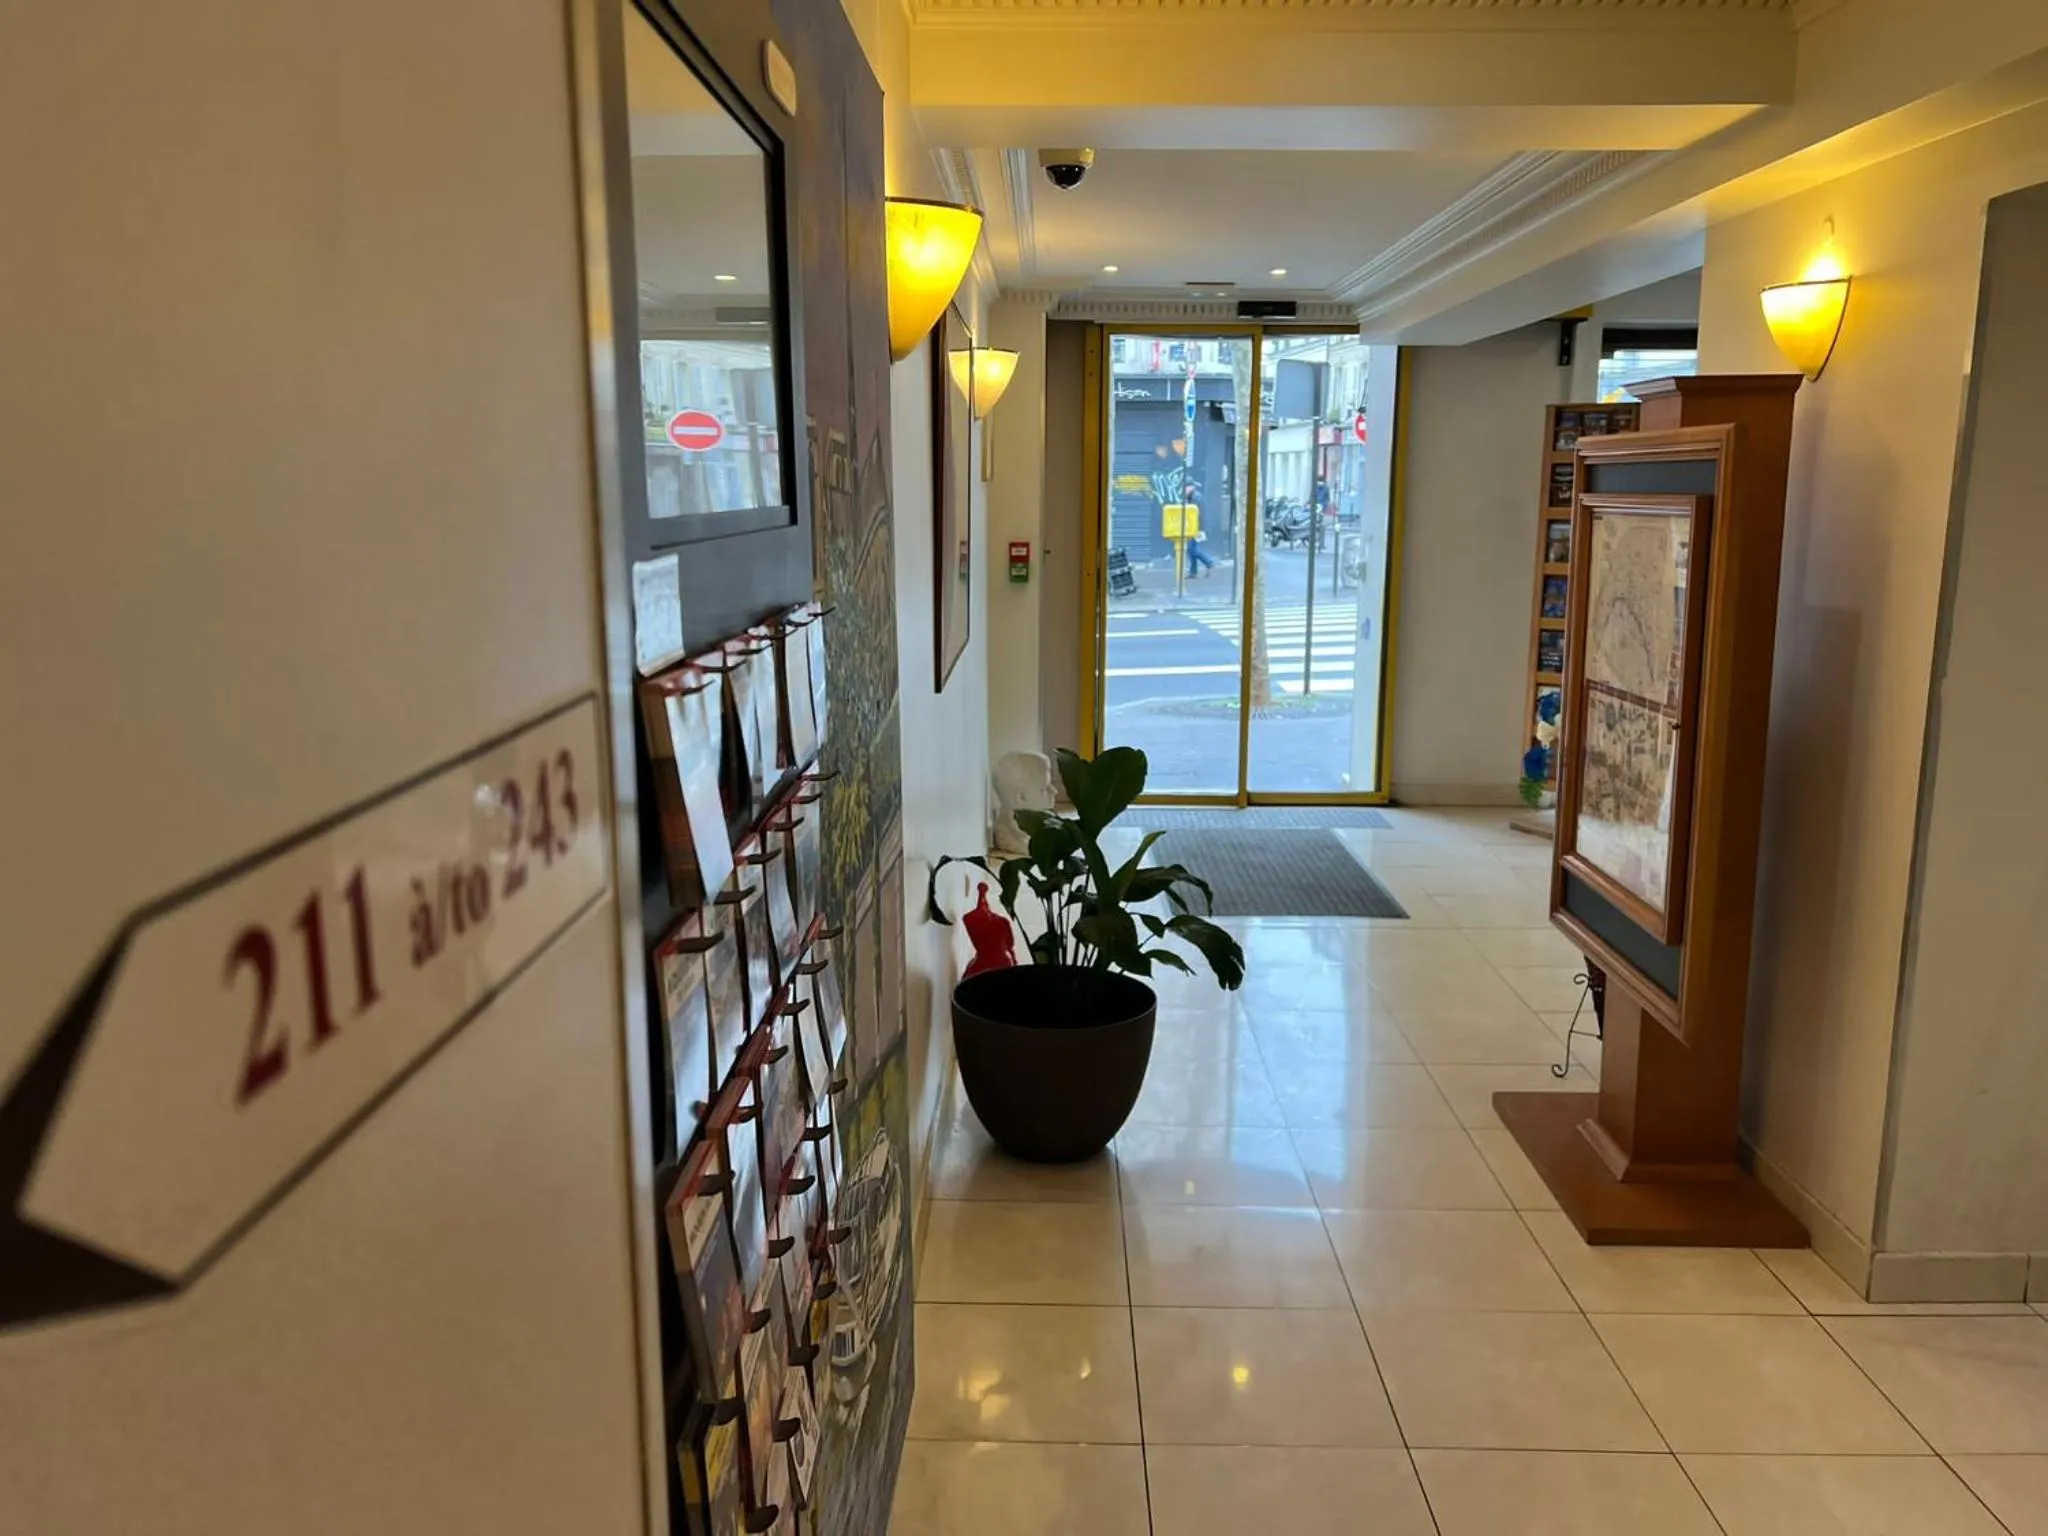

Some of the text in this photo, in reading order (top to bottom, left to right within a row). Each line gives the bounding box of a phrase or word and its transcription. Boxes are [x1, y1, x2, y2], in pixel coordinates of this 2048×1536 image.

[224, 749, 579, 1109] 211 à/to 243
